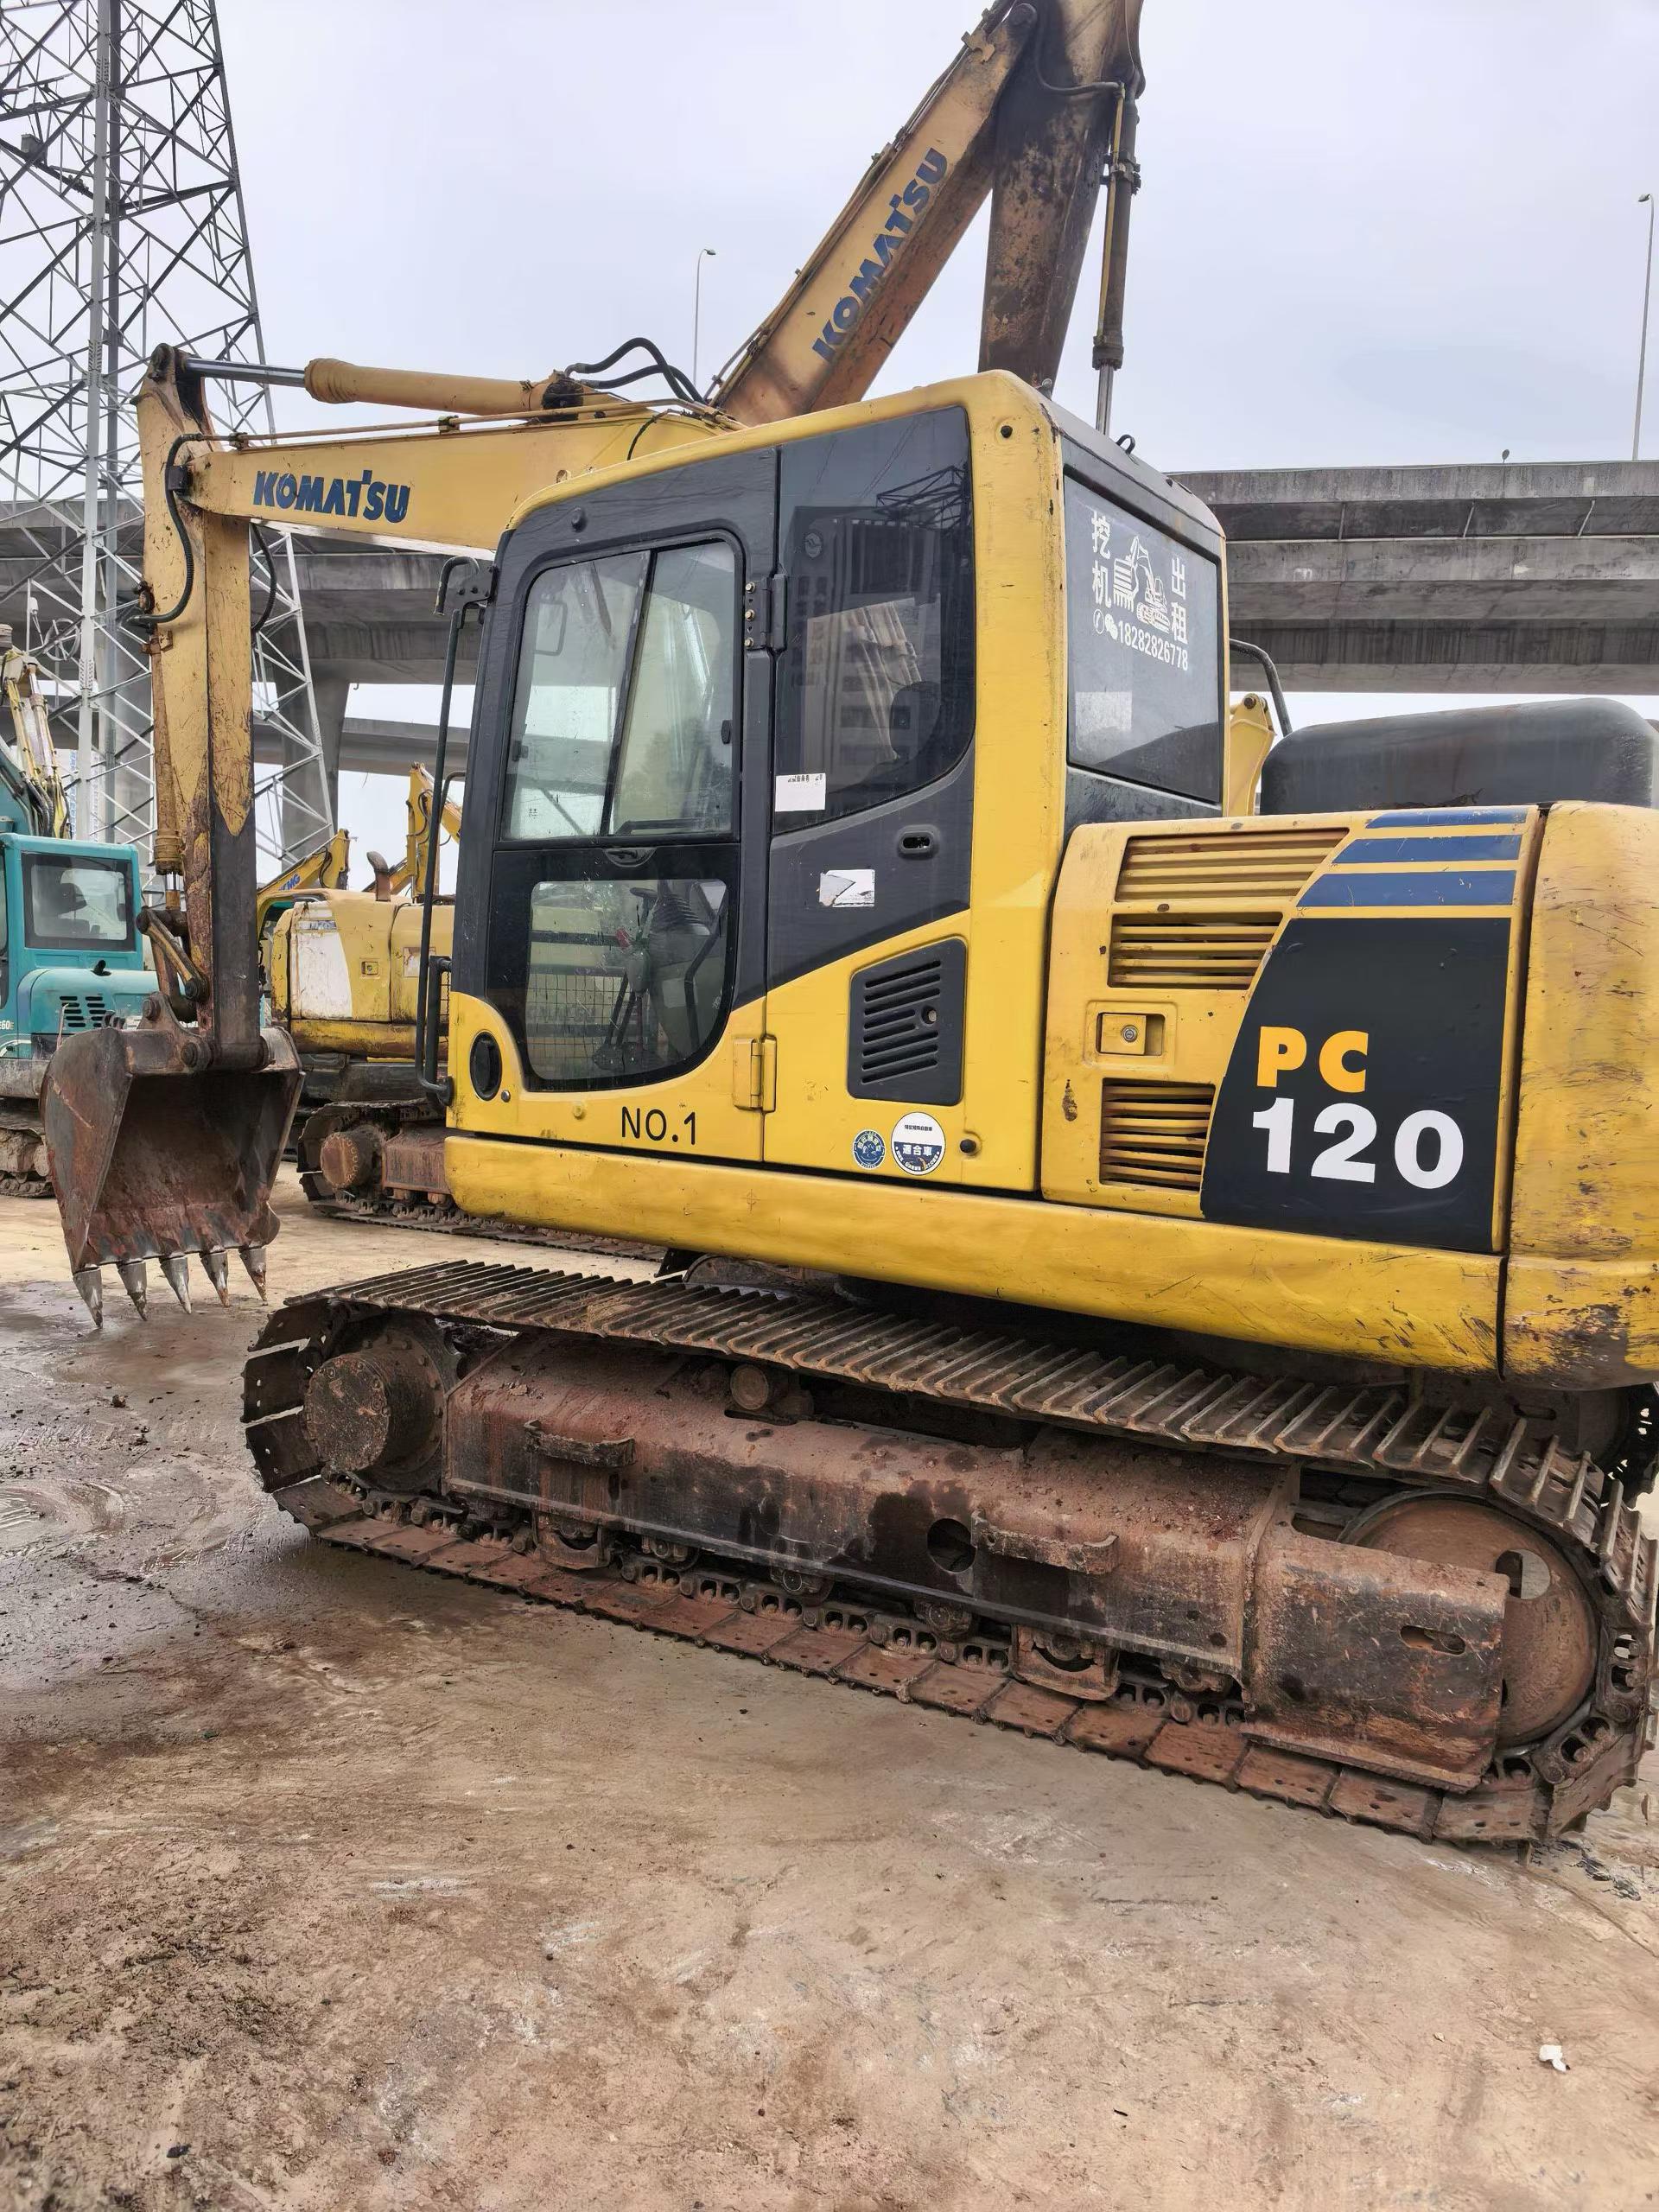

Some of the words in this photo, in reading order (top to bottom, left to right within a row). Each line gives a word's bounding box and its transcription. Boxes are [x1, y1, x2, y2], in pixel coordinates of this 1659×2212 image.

[812, 147, 948, 363] KOMATSU
[253, 469, 410, 524] KOMATSU
[1091, 511, 1112, 608] 挖机
[1171, 556, 1188, 645] 出租
[1256, 1026, 1369, 1093] PC
[621, 1106, 696, 1145] NO.1
[1252, 1097, 1464, 1189] 120
